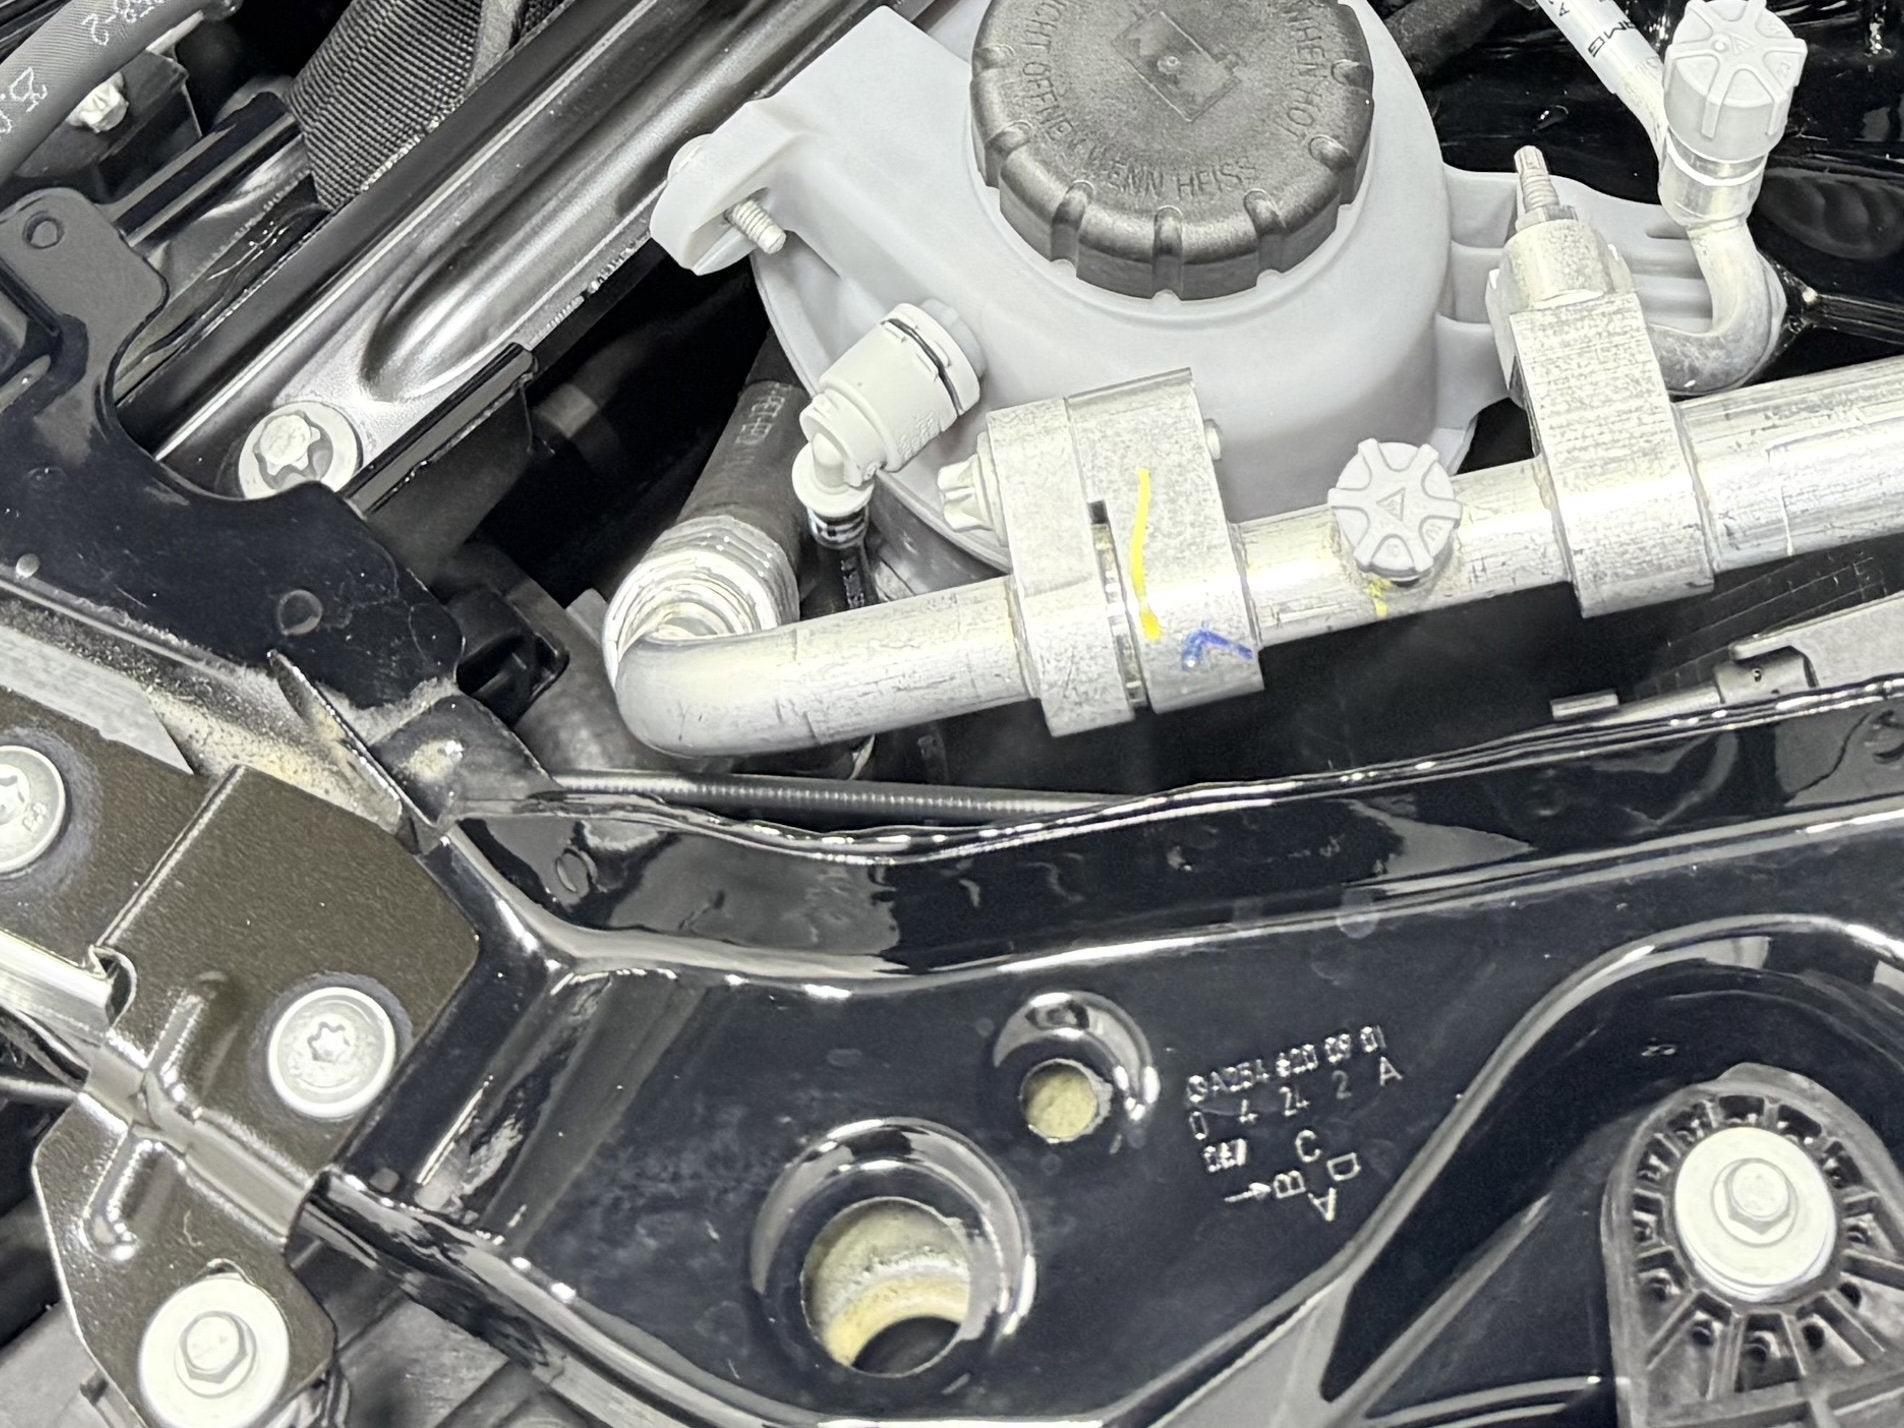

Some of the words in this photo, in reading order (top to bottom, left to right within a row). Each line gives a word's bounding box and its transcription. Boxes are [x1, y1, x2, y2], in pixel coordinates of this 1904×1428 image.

[1553, 0, 1571, 18] A
[1329, 1067, 1353, 1100] 2
[1373, 1051, 1403, 1086] A
[1292, 1127, 1323, 1165] C
[1271, 1168, 1306, 1199] B
[1324, 1151, 1363, 1184] D
[1308, 1188, 1338, 1222] A
